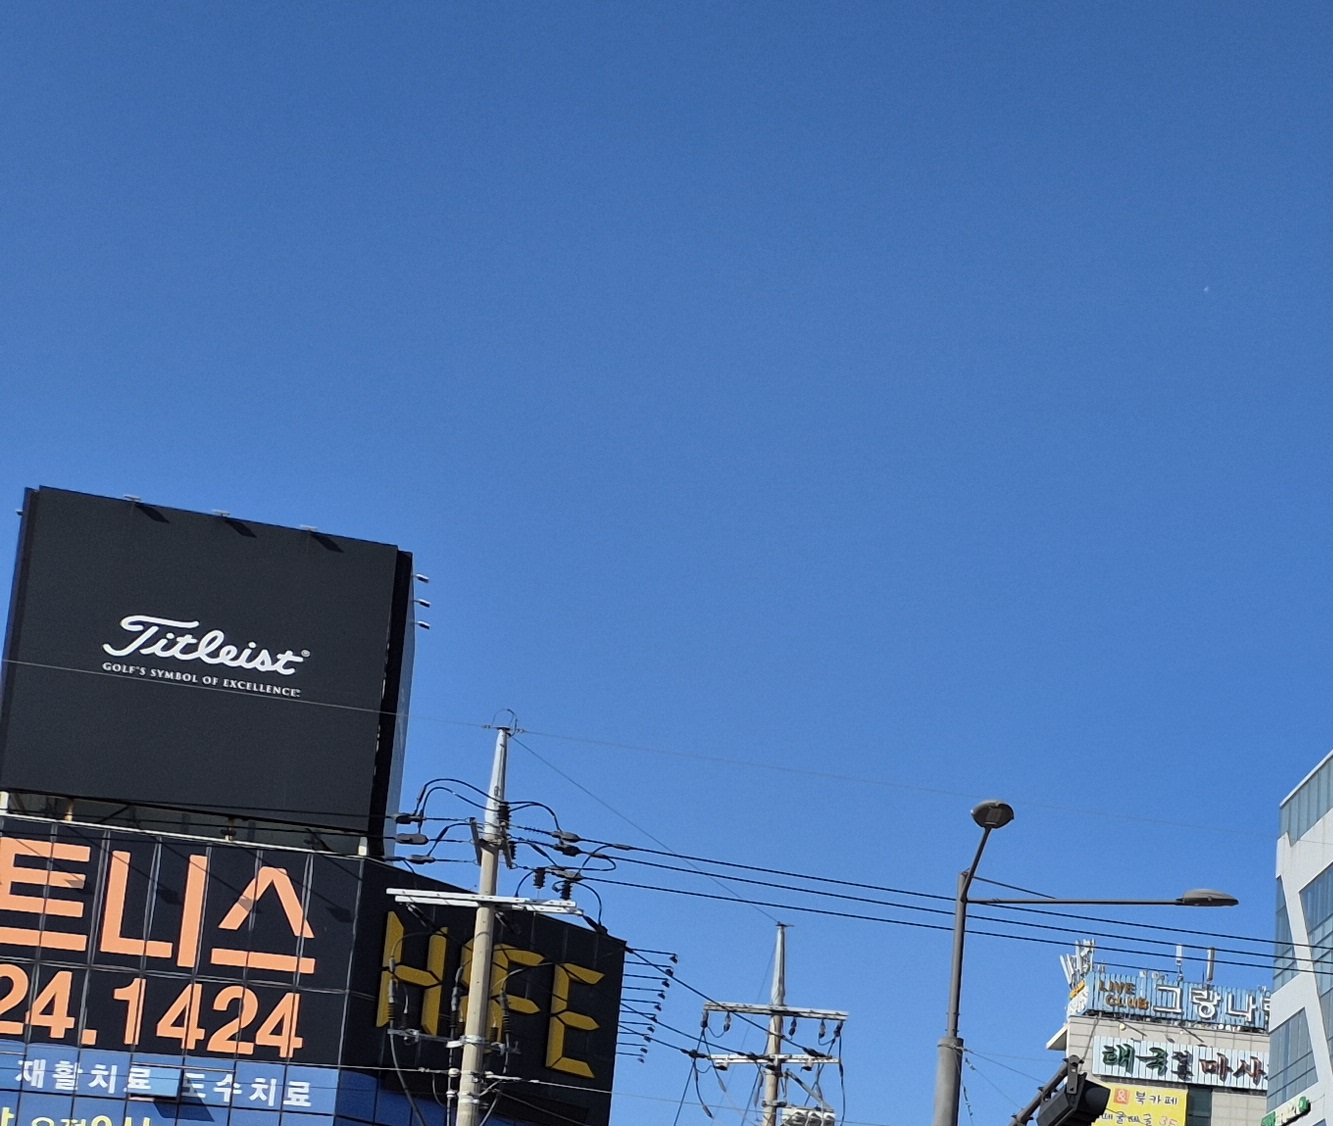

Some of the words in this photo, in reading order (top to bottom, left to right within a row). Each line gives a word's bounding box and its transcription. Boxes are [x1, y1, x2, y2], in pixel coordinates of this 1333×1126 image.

[102, 615, 304, 676] Titleist
[102, 662, 146, 676] GOLF'S
[150, 668, 198, 683] SYMBOL
[202, 675, 219, 687] OF
[223, 678, 300, 697] EXCELLENCE
[15, 1058, 151, 1095] 재활치료
[182, 1072, 312, 1108] 도수치료
[1101, 1042, 1269, 1087] 태국마사
